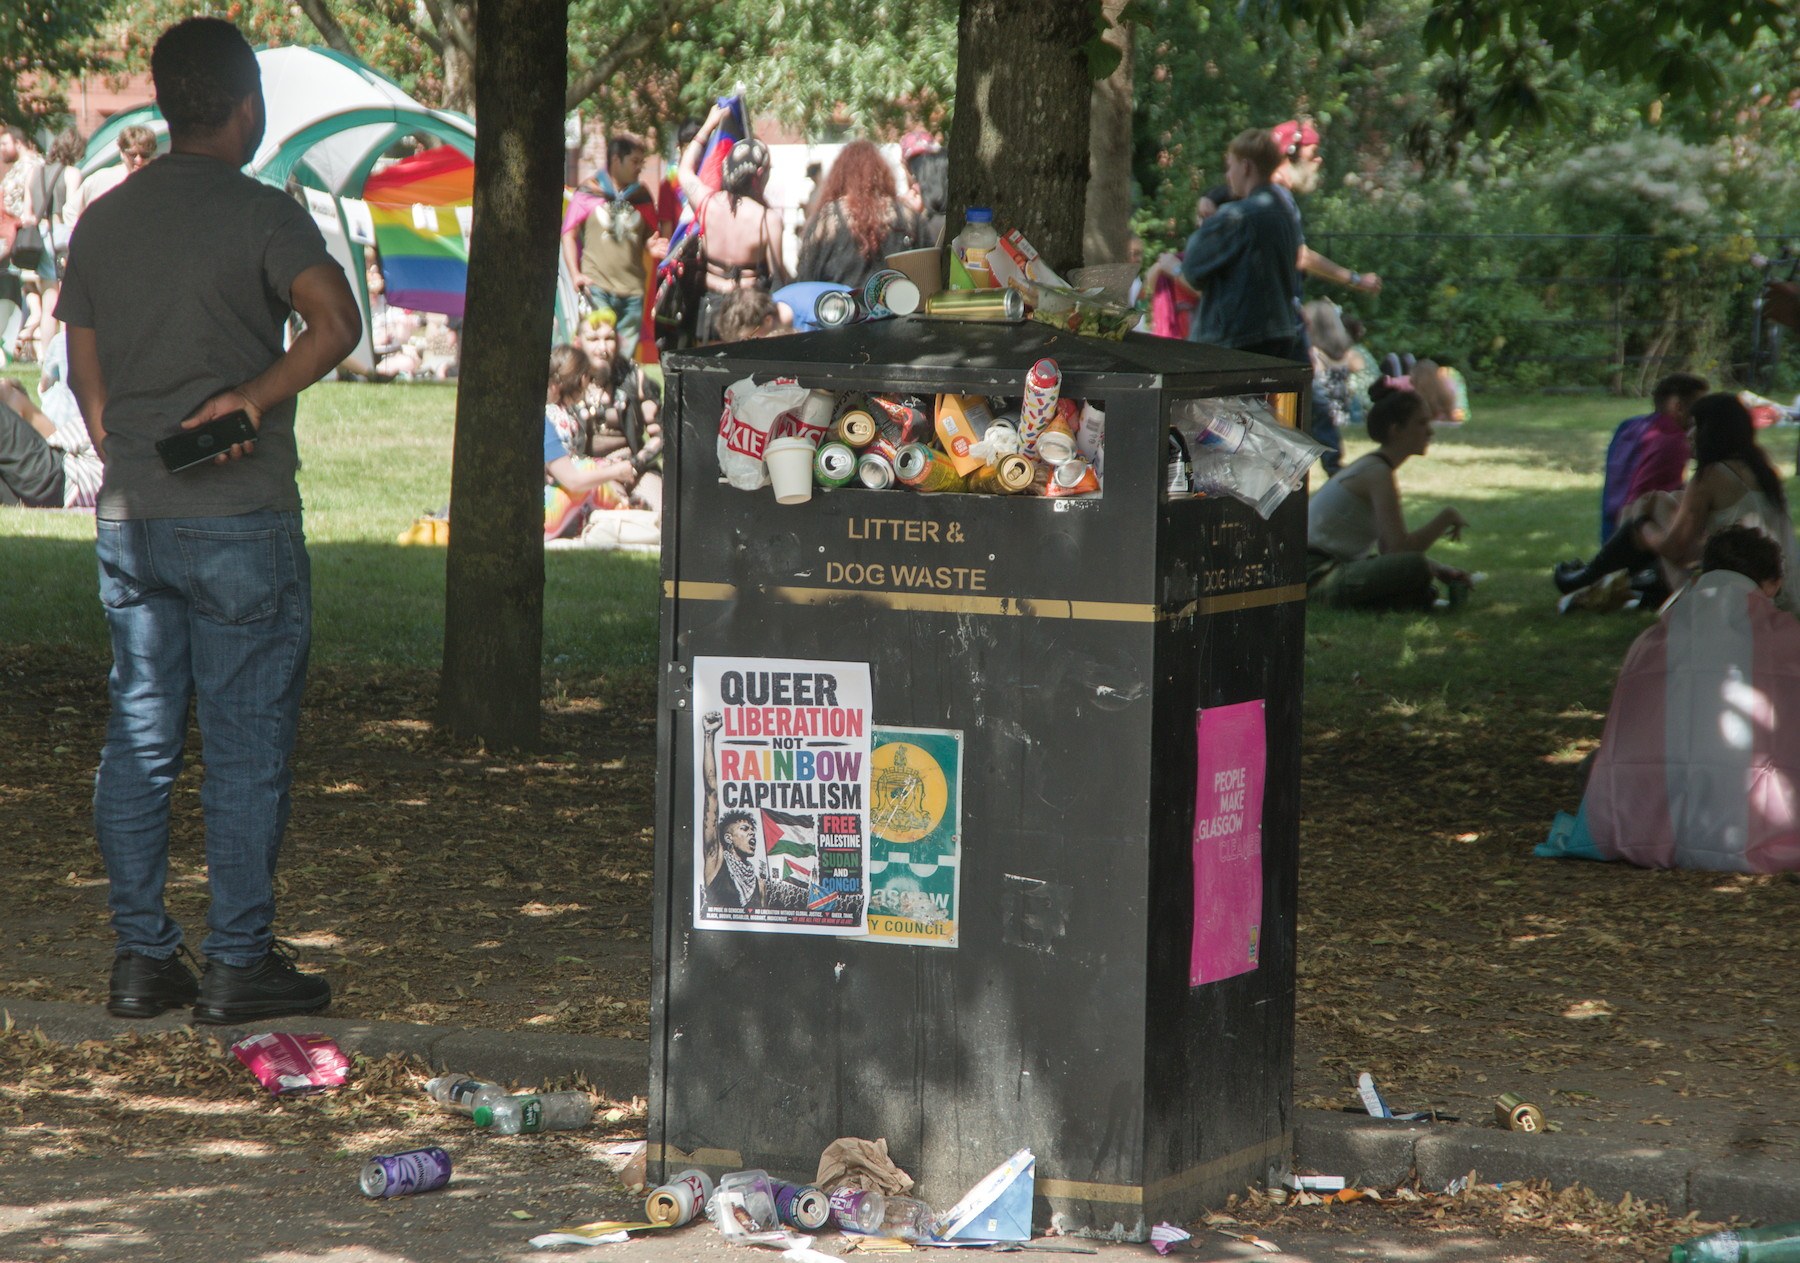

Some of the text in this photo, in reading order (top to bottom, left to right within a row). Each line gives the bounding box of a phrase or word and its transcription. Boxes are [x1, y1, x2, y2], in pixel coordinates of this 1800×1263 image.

[848, 517, 965, 543] LITTER &
[826, 562, 987, 591] DOG WASTE
[720, 670, 838, 707] QUEER
[724, 707, 863, 737] LIBERATION
[772, 738, 803, 750] NOT
[721, 750, 862, 781] RAINBOW
[1215, 767, 1246, 793] PEOPLE
[722, 782, 861, 810] CAPITALISM
[1220, 789, 1245, 814] MAKE
[823, 815, 856, 834] FREE
[1199, 811, 1244, 840] GLASGOW
[820, 834, 861, 848] PALESTINE
[822, 852, 858, 867] SUDAN
[822, 878, 859, 892] CONGO!
[833, 868, 848, 877] AND
[870, 919, 879, 931] Y
[884, 921, 948, 936] COUNCIL
